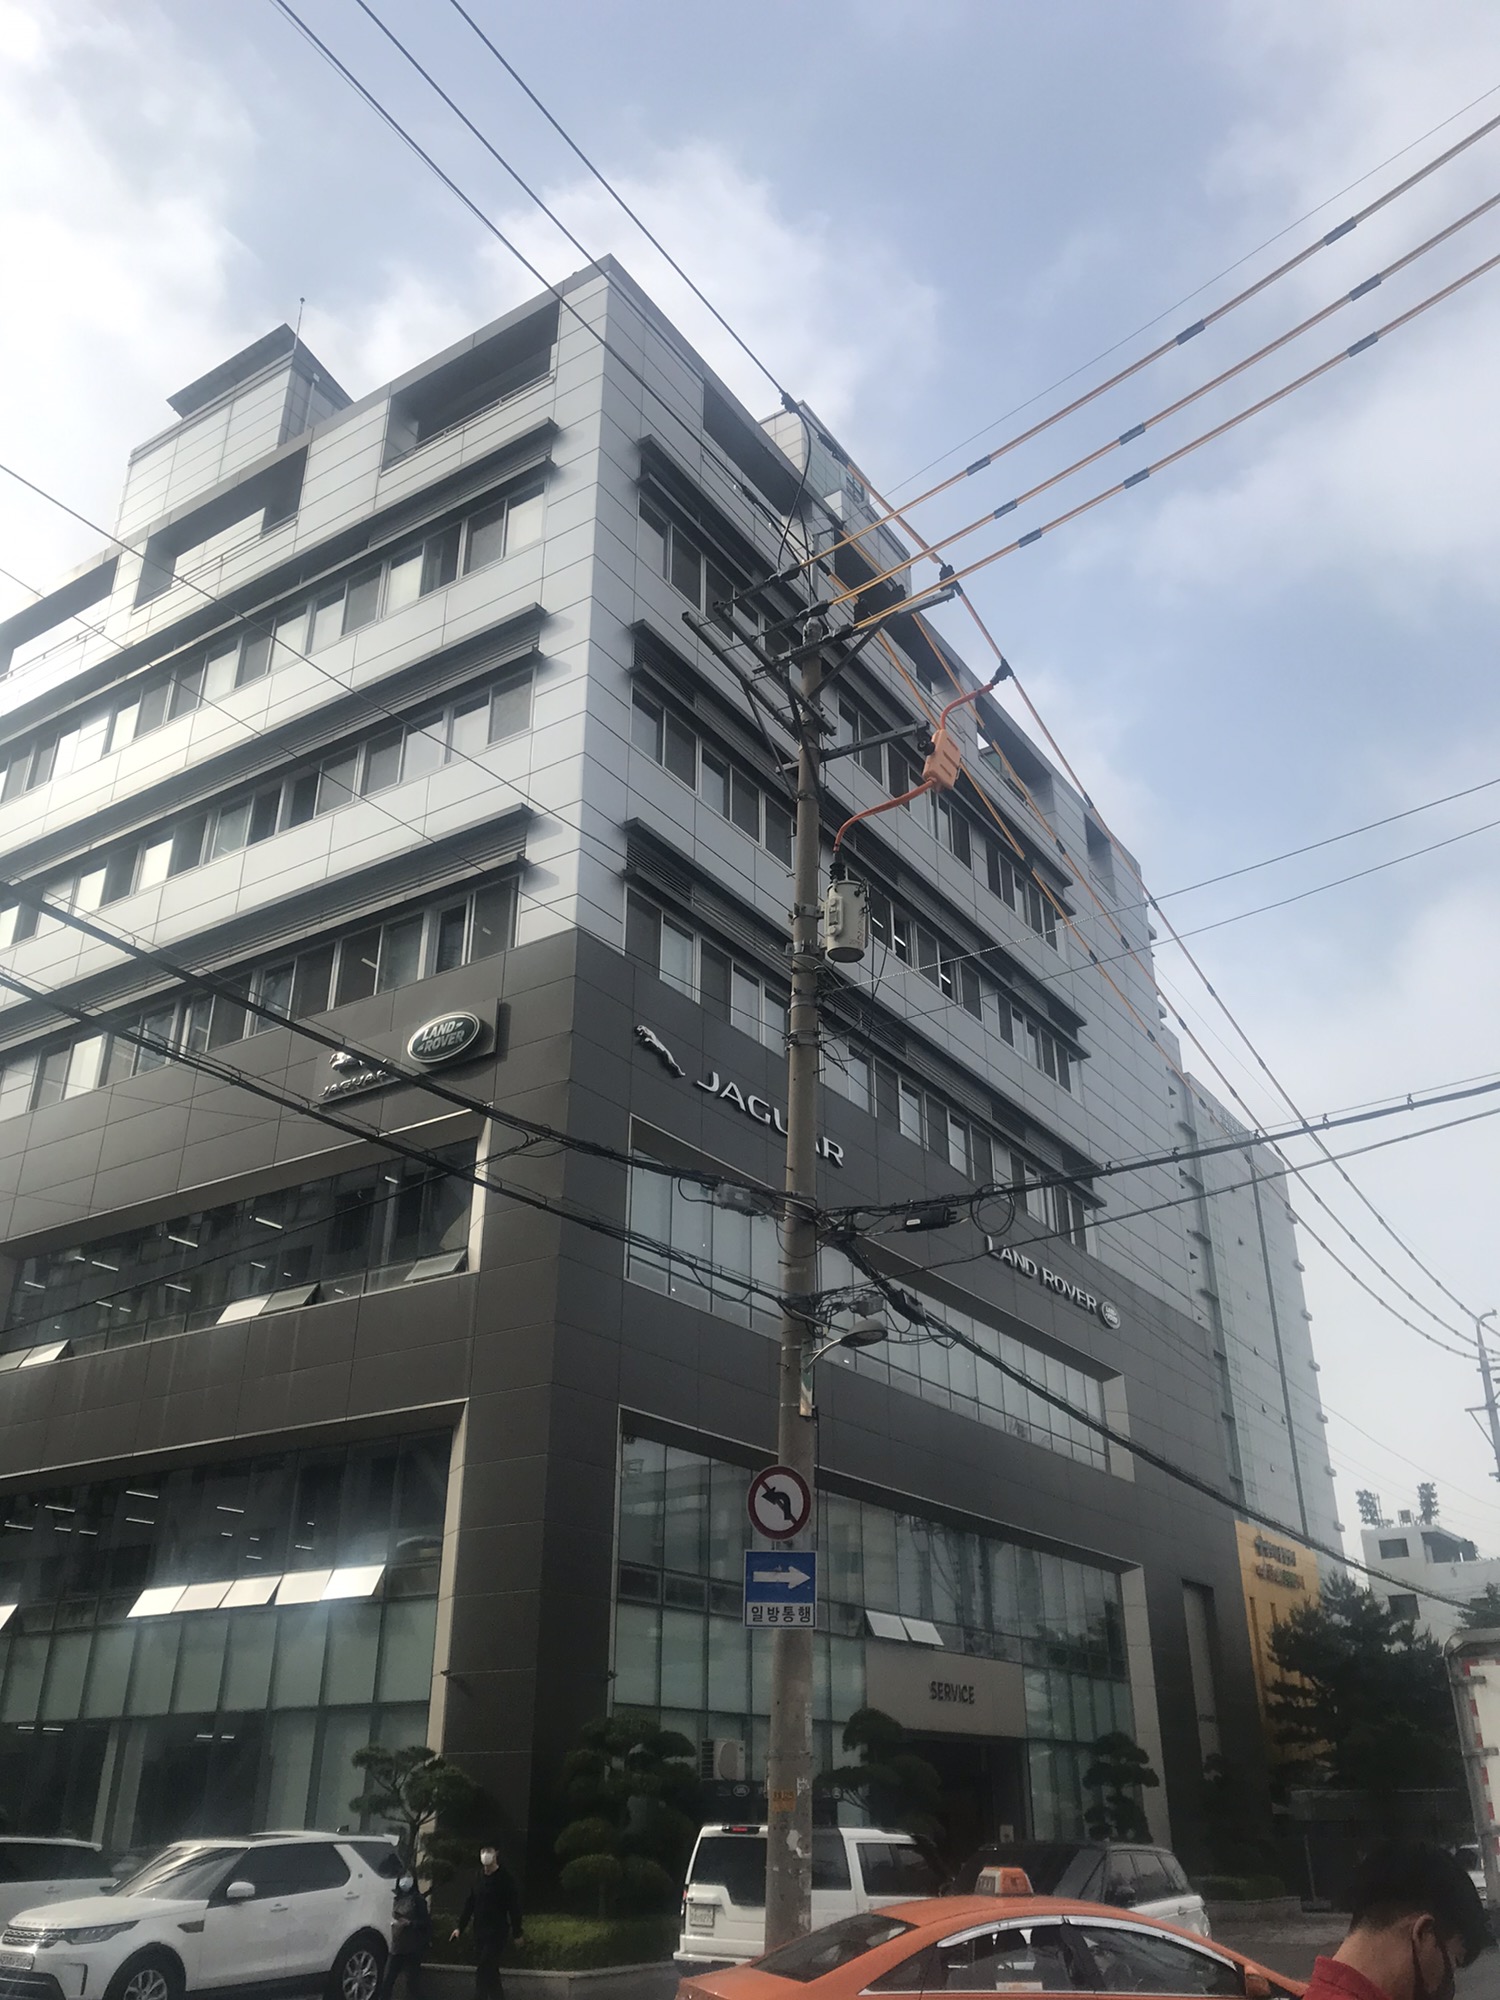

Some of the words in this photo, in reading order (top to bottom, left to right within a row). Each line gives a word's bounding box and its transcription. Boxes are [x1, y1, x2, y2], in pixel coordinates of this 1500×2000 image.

[421, 1021, 456, 1042] LAND
[423, 1030, 465, 1053] ROVER
[697, 1071, 845, 1168] JAGUR
[985, 1235, 1038, 1277] LAND
[1042, 1266, 1098, 1314] ROVER
[751, 1606, 811, 1623] 일방통행
[929, 1680, 975, 1705] SERVICE
